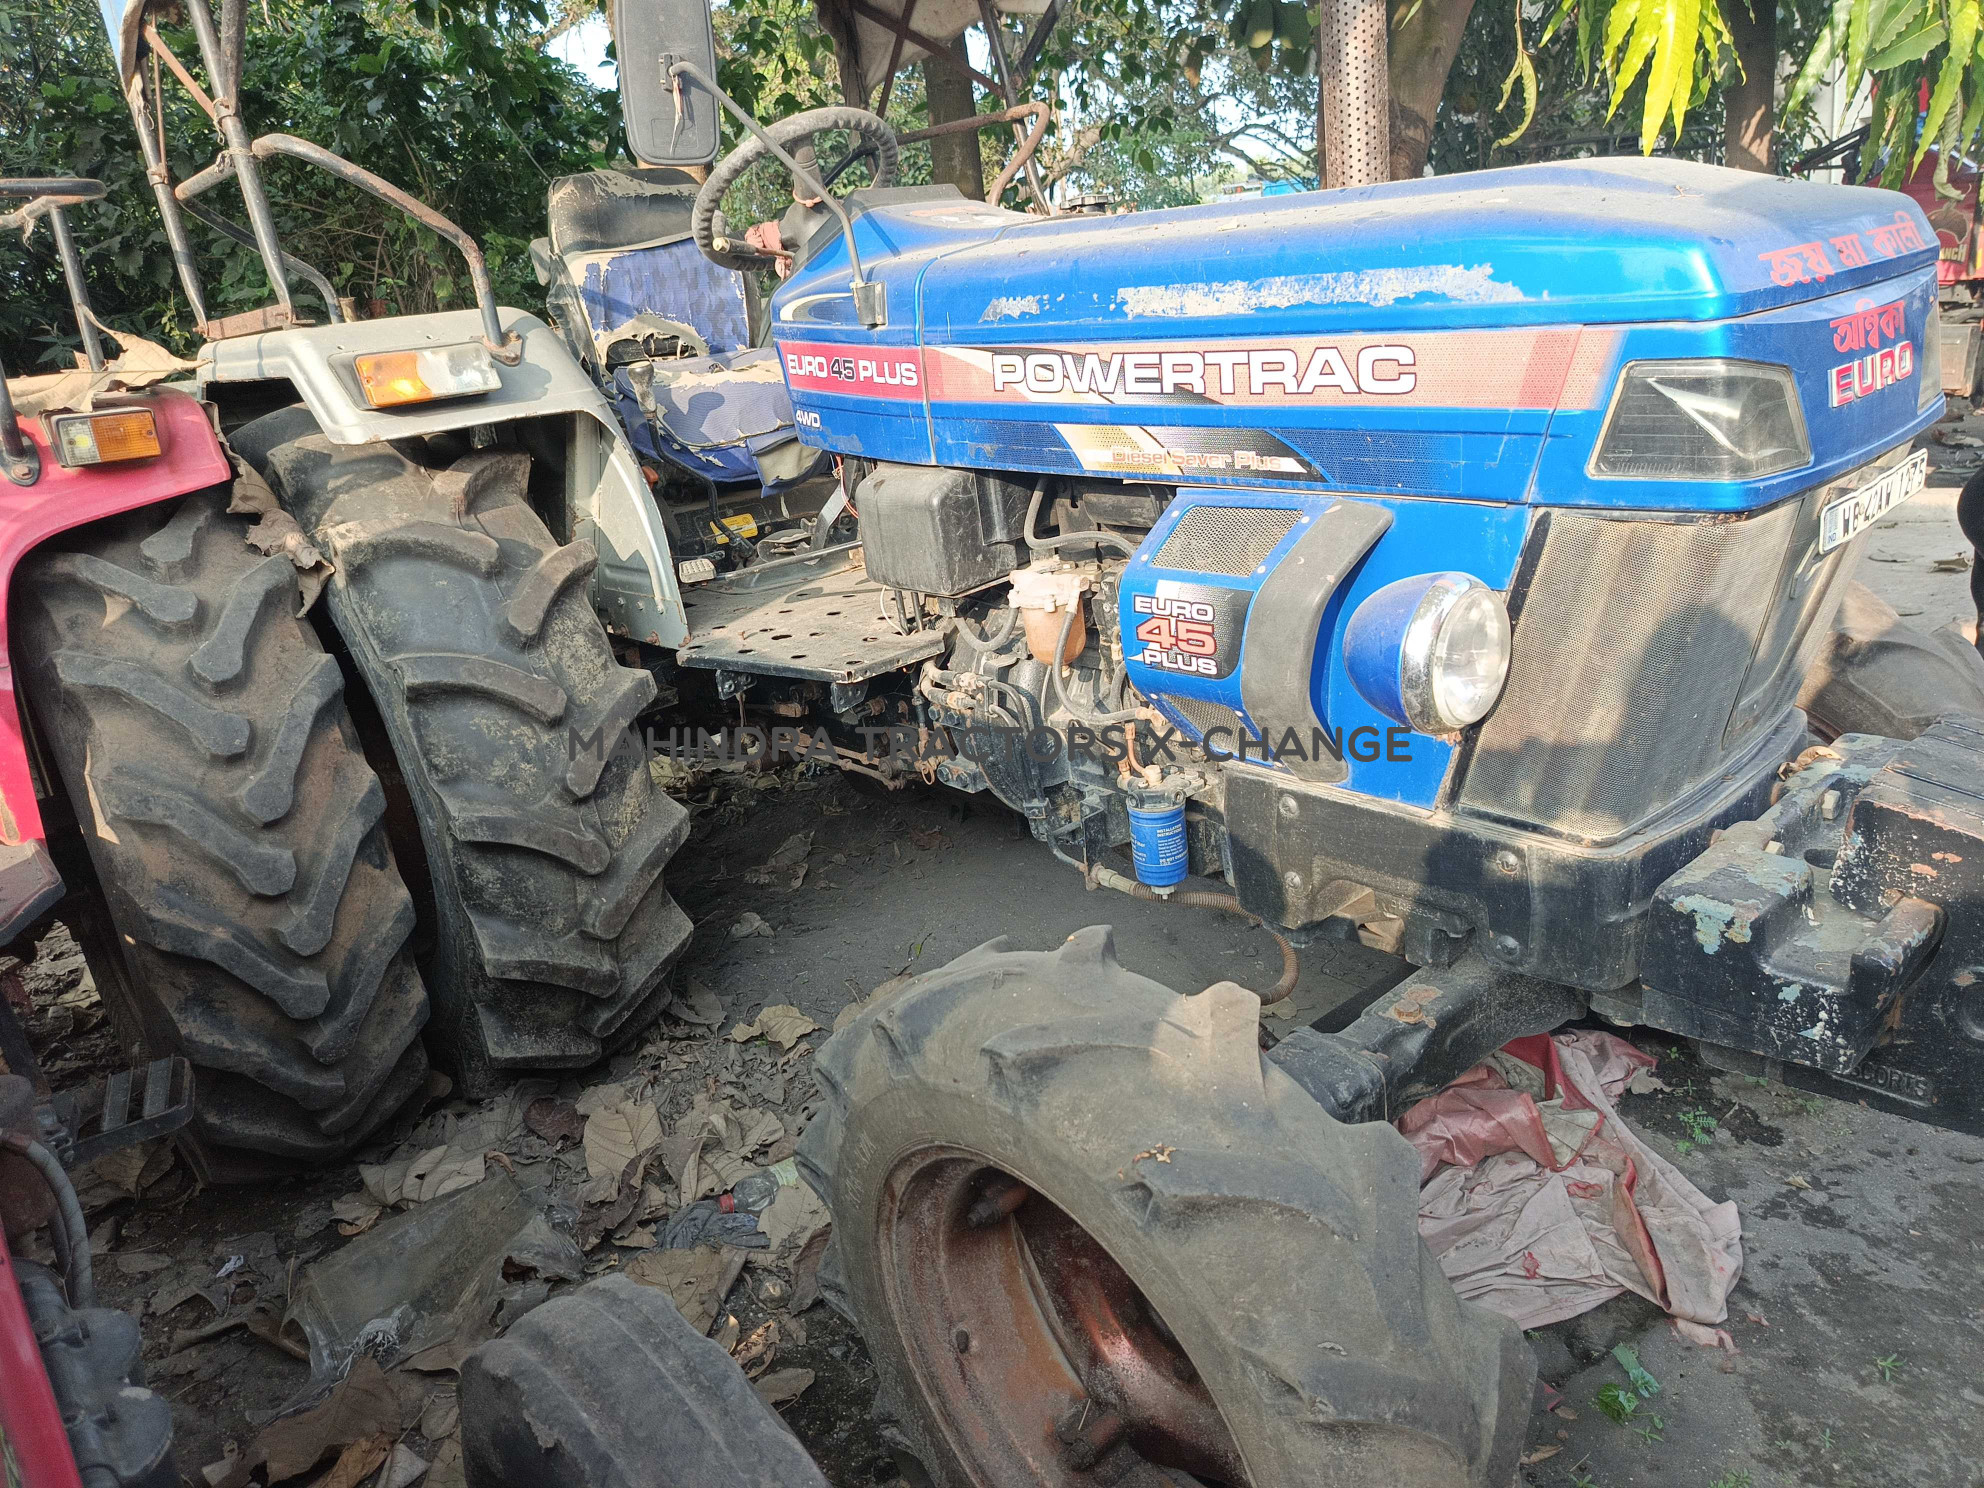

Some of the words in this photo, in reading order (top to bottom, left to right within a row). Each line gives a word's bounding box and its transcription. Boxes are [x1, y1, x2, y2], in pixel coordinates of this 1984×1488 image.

[1829, 233, 1871, 267] মা
[1865, 211, 1927, 259] কালী
[786, 354, 828, 378] EURO
[830, 356, 856, 382] 45
[858, 360, 918, 386] PLUS
[992, 345, 1417, 395] POWERTRAC
[1827, 340, 1914, 409] EURO
[795, 410, 821, 428] 4WD
[1112, 450, 1168, 465] Diesel
[1171, 450, 1232, 468] Saver
[1234, 451, 1282, 470] Plus
[1134, 594, 1215, 622] EURO
[1136, 615, 1217, 656] 45
[1142, 648, 1218, 675] PLUS
[1850, 1060, 1928, 1097] SCORTS
